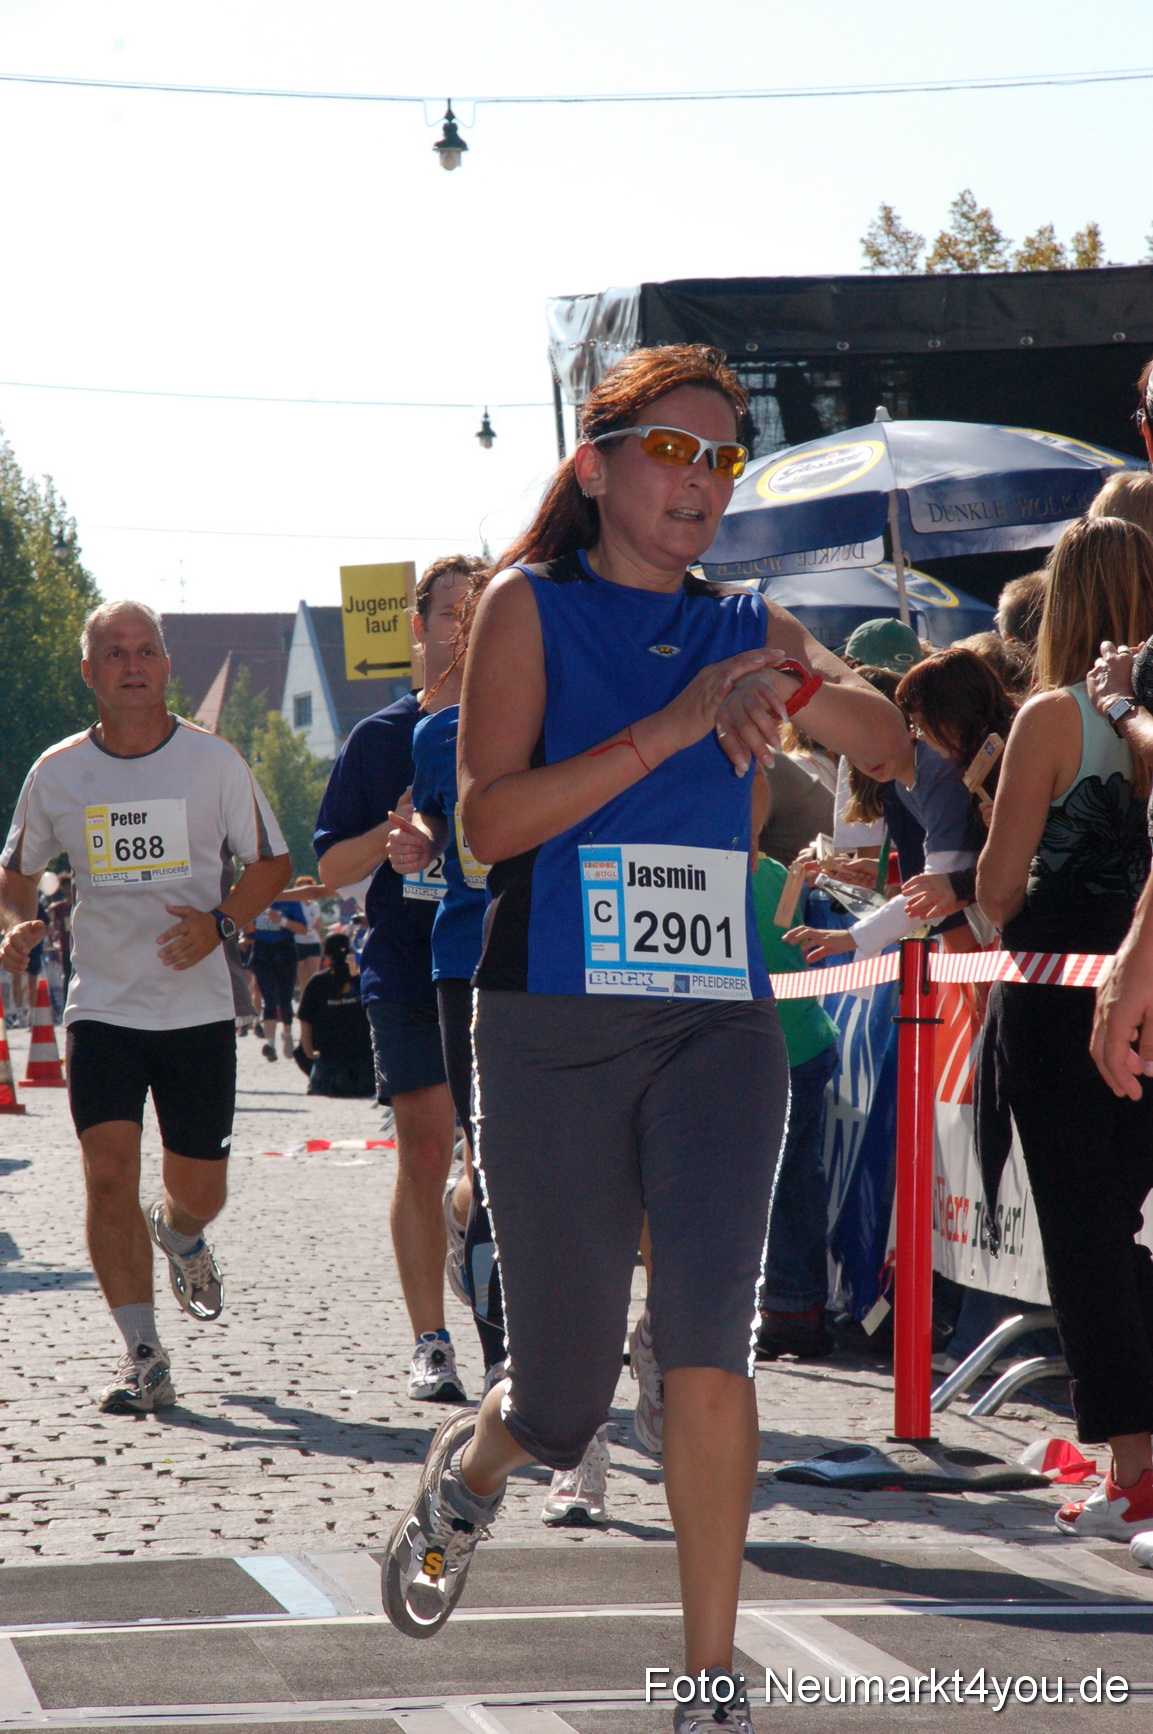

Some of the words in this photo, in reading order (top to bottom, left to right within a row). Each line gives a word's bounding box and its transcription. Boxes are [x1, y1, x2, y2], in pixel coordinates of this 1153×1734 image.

[928, 502, 1008, 523] DUNKLE
[345, 592, 408, 616] Jugend
[366, 614, 398, 633] lauf
[110, 812, 147, 827] Peter
[93, 836, 103, 848] D
[115, 835, 164, 861] 688
[152, 866, 189, 876] PFLEIDERER
[627, 861, 706, 891] Jasmin
[594, 900, 612, 922] C
[633, 910, 732, 958] 2901
[590, 971, 653, 985] BOCK
[692, 975, 748, 990] PFLEIDERER
